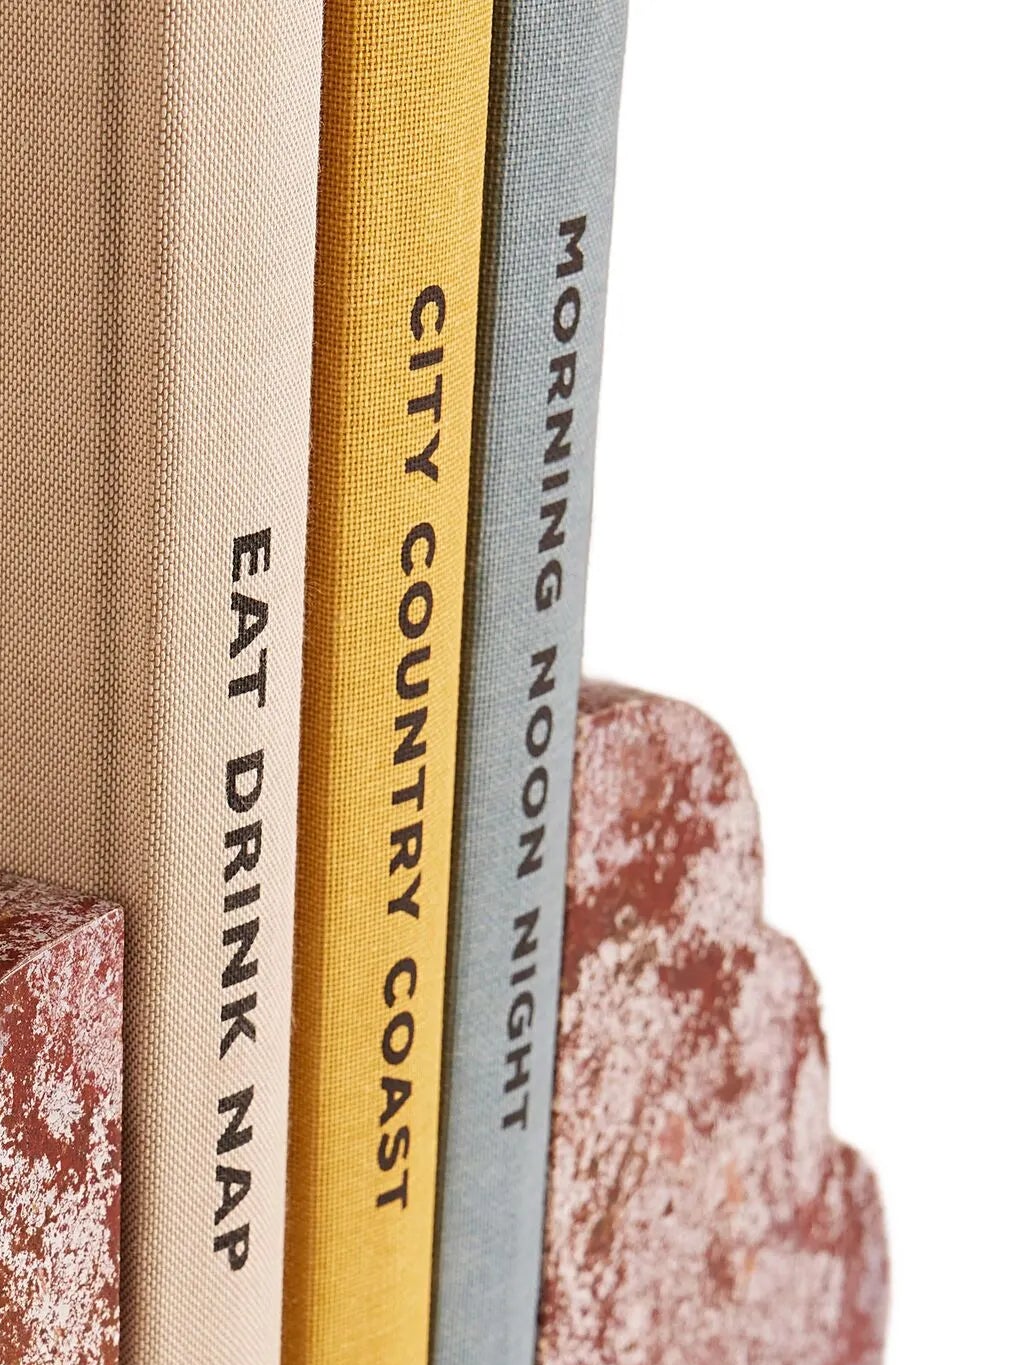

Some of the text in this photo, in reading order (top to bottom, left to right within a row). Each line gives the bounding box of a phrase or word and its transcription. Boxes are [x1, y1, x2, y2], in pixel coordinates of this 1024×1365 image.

[213, 527, 272, 1272] EAT DRINK NAP
[376, 284, 446, 1209] CITY COUNTRY COAST
[501, 215, 587, 1131] MORNING NOON NIGHT
